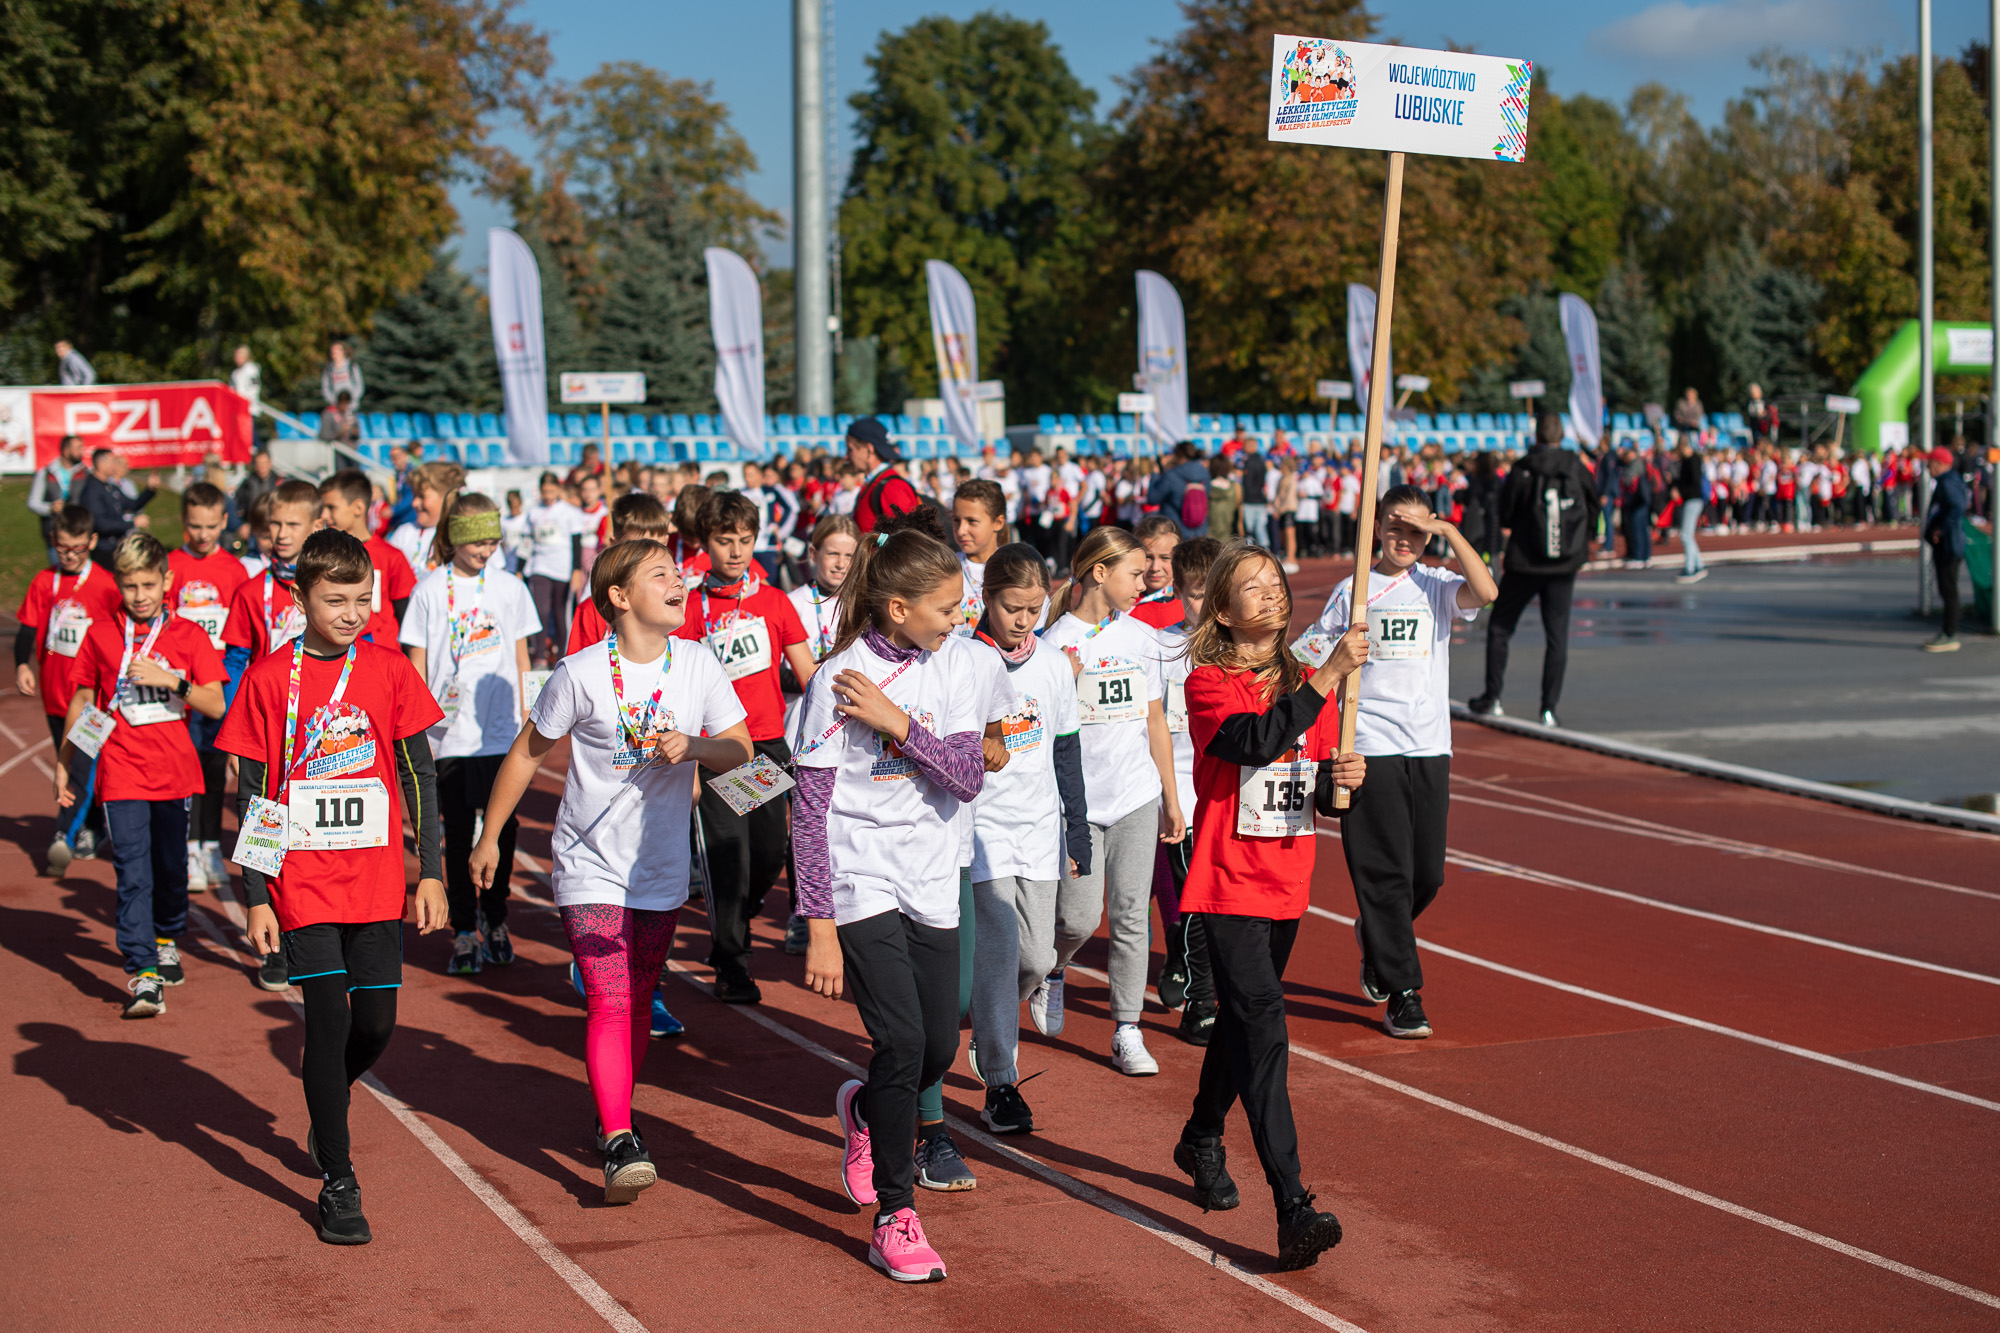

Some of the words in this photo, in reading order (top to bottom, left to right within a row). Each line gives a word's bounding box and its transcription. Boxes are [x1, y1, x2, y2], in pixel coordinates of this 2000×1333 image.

[1389, 62, 1476, 92] WOJEWÓDZTWO
[1275, 114, 1311, 125] NADZIEJE
[1311, 109, 1356, 121] OLIMPIJSKIE
[1277, 99, 1359, 116] LEKKOATLETYCZNE
[1395, 93, 1465, 126] LUBUSKIE
[1278, 122, 1306, 132] NAJLEPSI
[1311, 118, 1352, 128] NAJLEPSZYCH
[64, 396, 223, 442] PZLA
[1381, 618, 1419, 641] 127
[878, 671, 898, 690] DZIEJE
[1098, 678, 1133, 705] 131
[135, 685, 170, 705] 119
[307, 762, 338, 778] NADZIEJE
[339, 749, 375, 768] OLIMPIJSKIE
[308, 740, 375, 770] LEKKOATLETYCZNE
[870, 766, 905, 776] NADZIEJE
[728, 776, 763, 801] ZAWODNIK
[1263, 780, 1307, 811] 135
[315, 797, 364, 828] 110
[245, 835, 281, 850] ZAWODNIK
